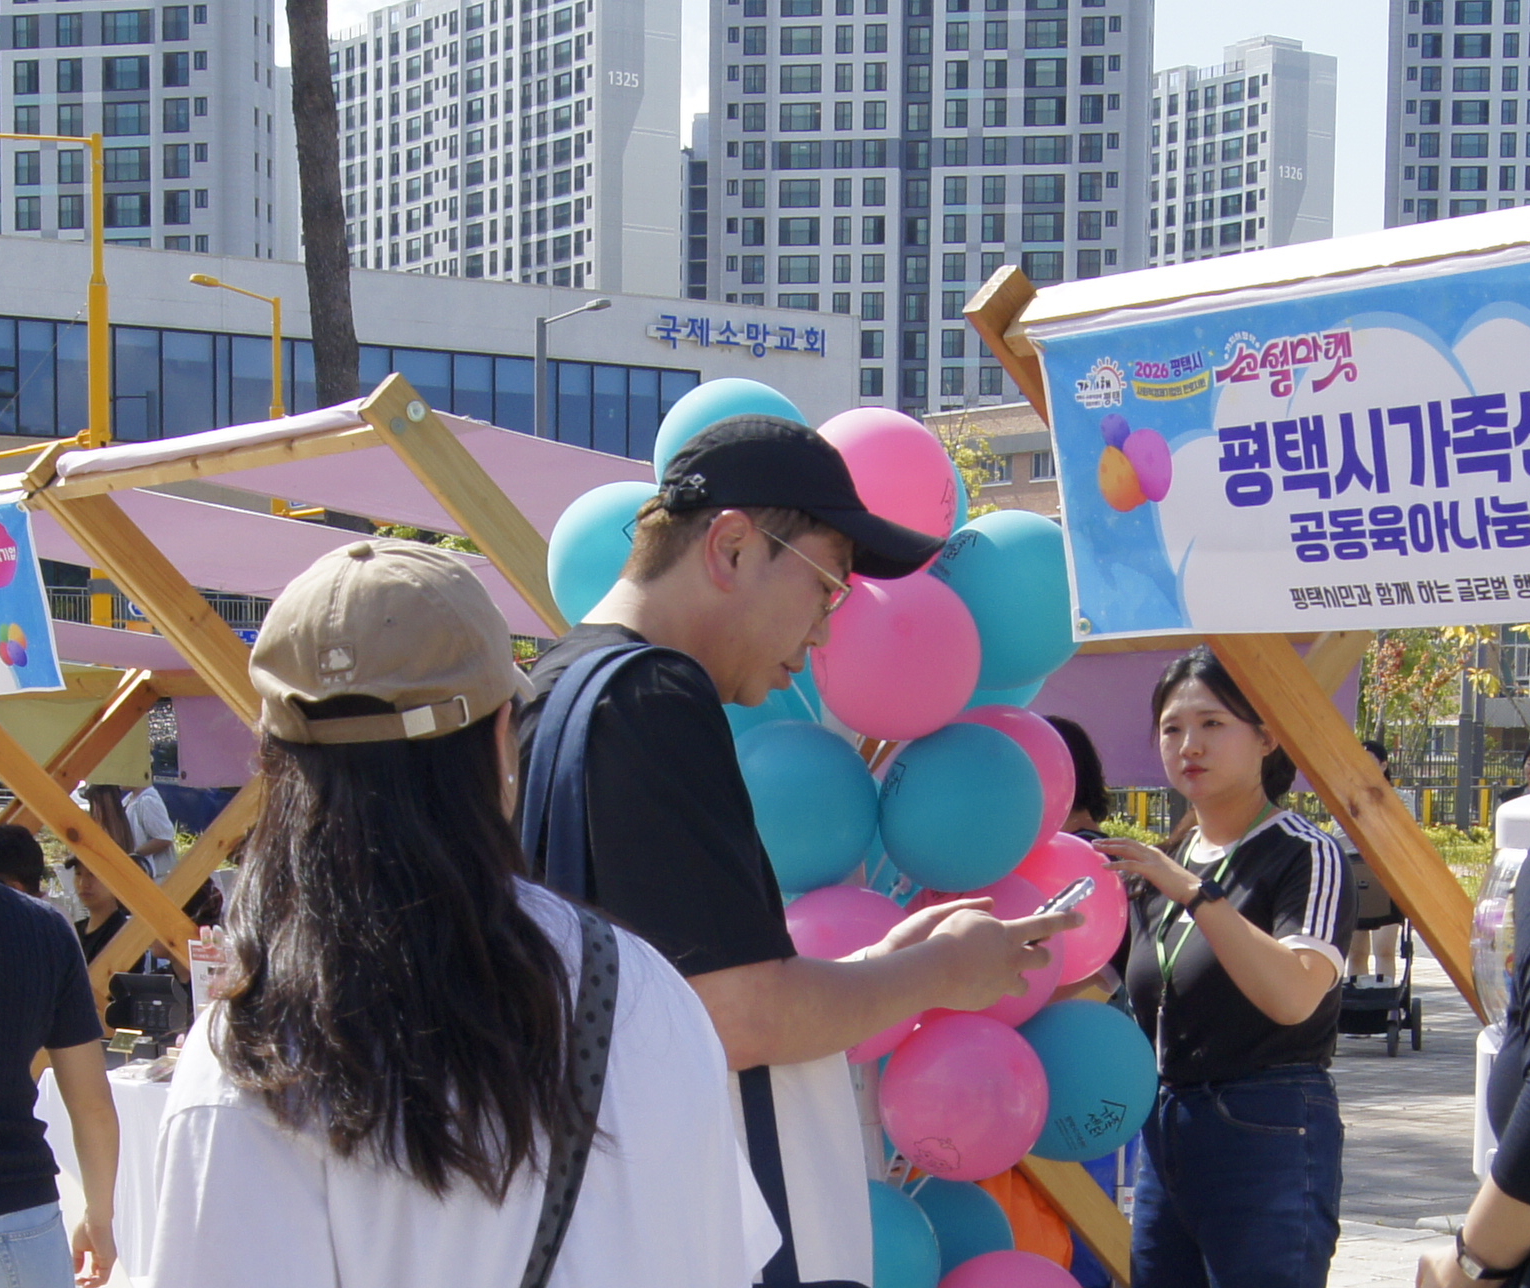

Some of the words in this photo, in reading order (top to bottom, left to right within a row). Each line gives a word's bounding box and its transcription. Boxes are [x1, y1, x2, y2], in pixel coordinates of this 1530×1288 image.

[608, 71, 639, 88] 1325
[1279, 165, 1303, 181] 1326
[656, 314, 826, 358] 국제소망교회
[1134, 361, 1169, 379] 2026
[1170, 351, 1204, 377] 평택시
[1215, 331, 1358, 397] 소셜마켓
[1289, 584, 1373, 610] 평택시민과
[1375, 581, 1416, 606] 함께
[1416, 579, 1455, 604] 하는
[1455, 575, 1511, 602] 글로벌
